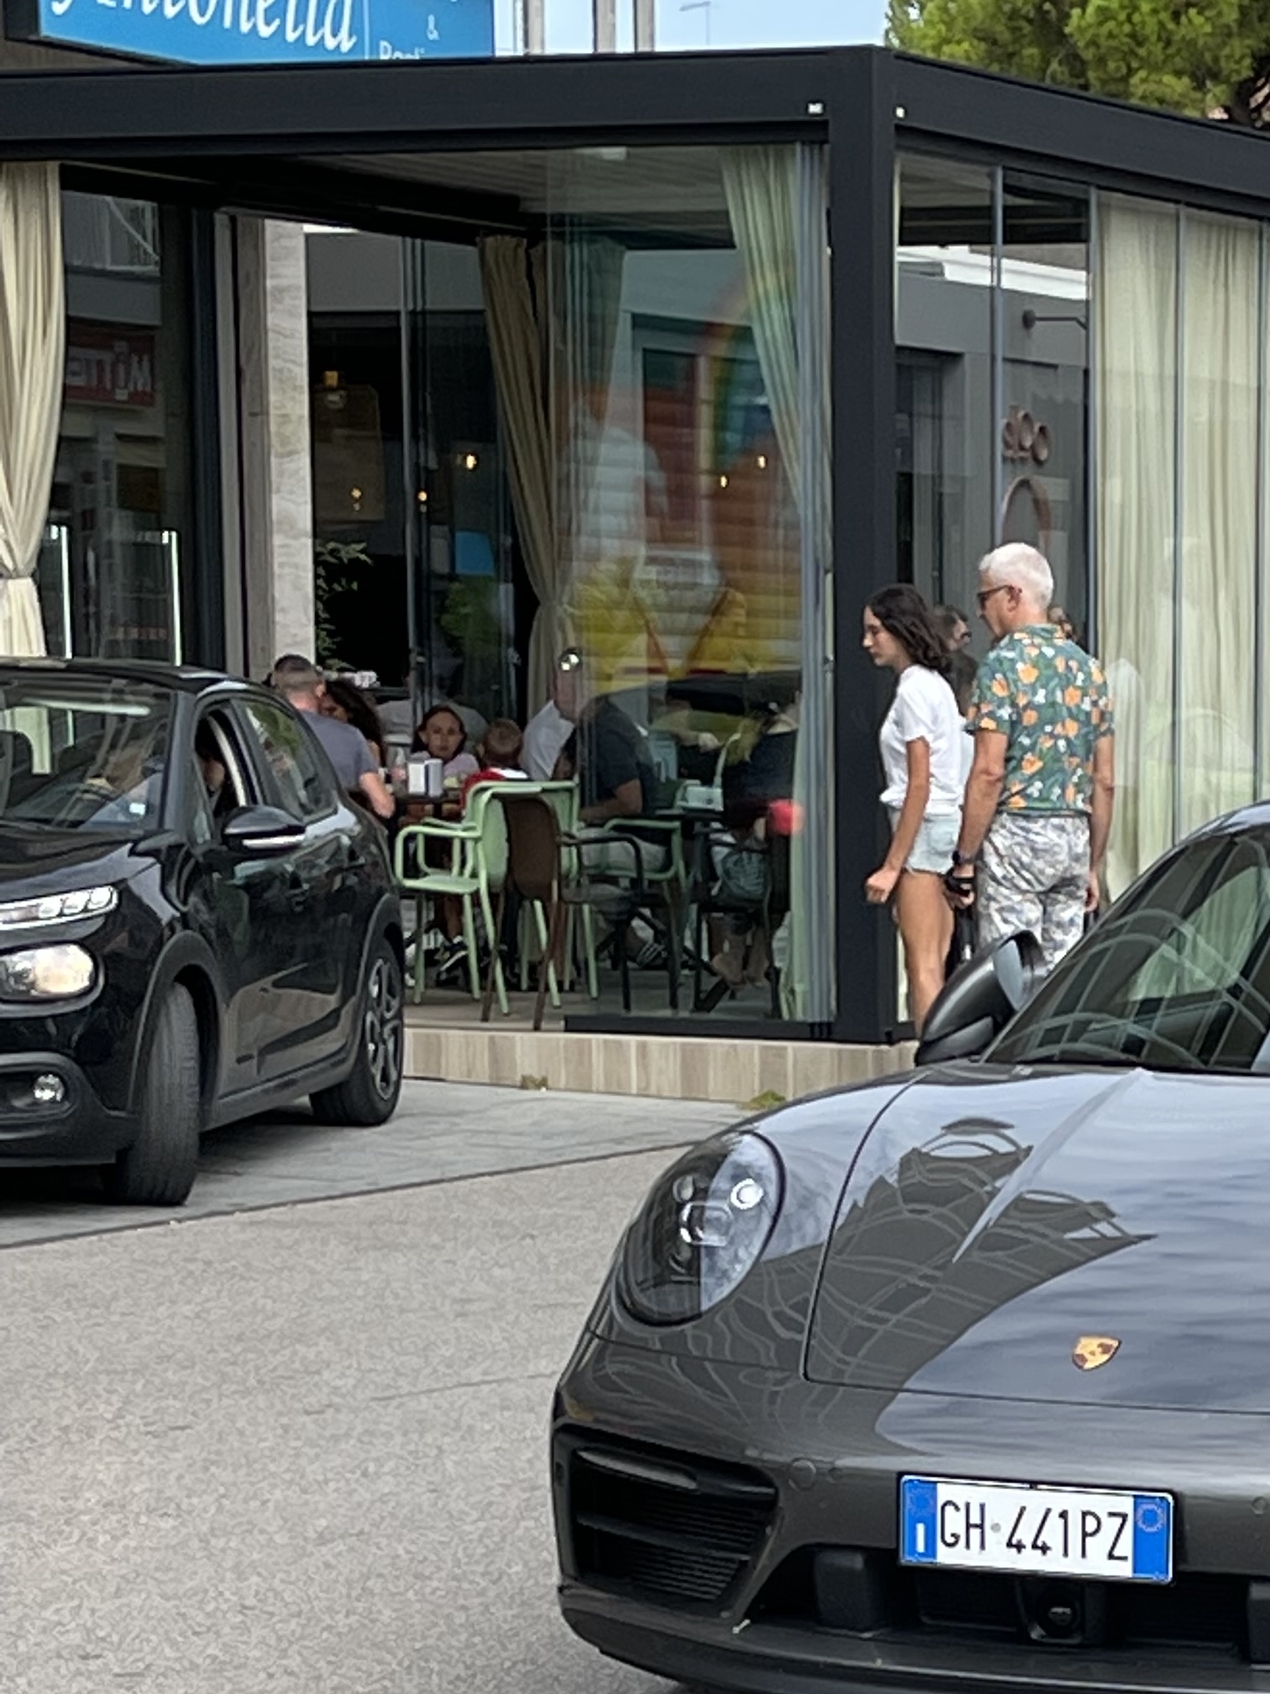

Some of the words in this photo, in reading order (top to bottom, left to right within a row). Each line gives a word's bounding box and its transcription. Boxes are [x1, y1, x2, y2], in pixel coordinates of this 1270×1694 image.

[426, 14, 440, 40] &
[940, 1500, 986, 1551] GH
[1006, 1506, 1129, 1561] 441PZ
